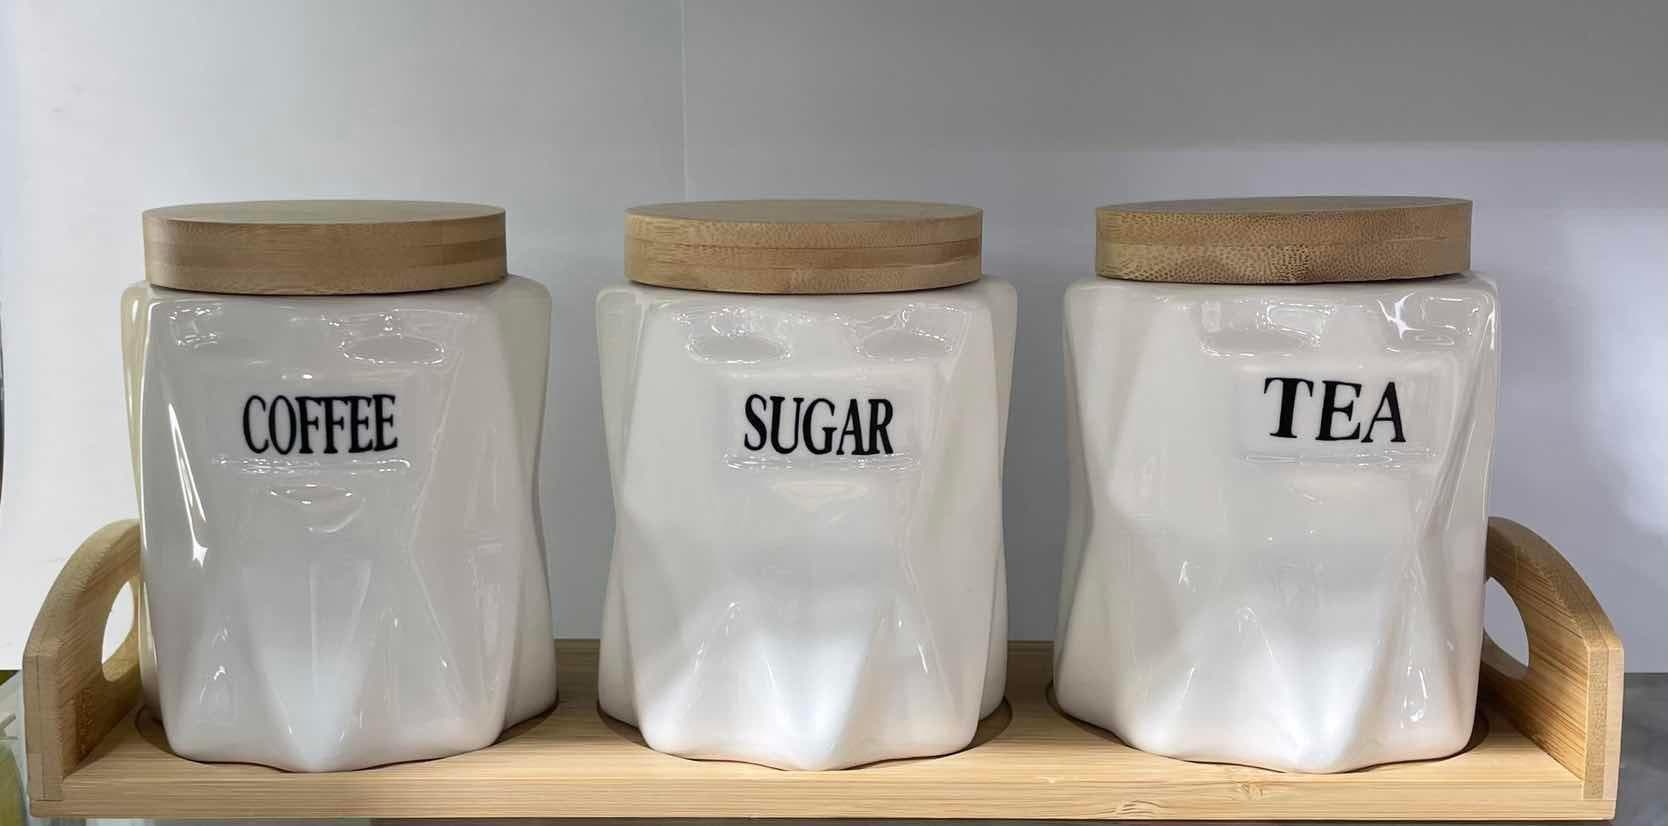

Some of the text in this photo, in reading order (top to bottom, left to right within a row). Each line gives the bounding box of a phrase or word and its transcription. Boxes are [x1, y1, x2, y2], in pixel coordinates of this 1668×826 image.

[242, 393, 399, 456] COFFEE
[742, 393, 894, 456] SUGAR
[1263, 376, 1407, 444] TEA
